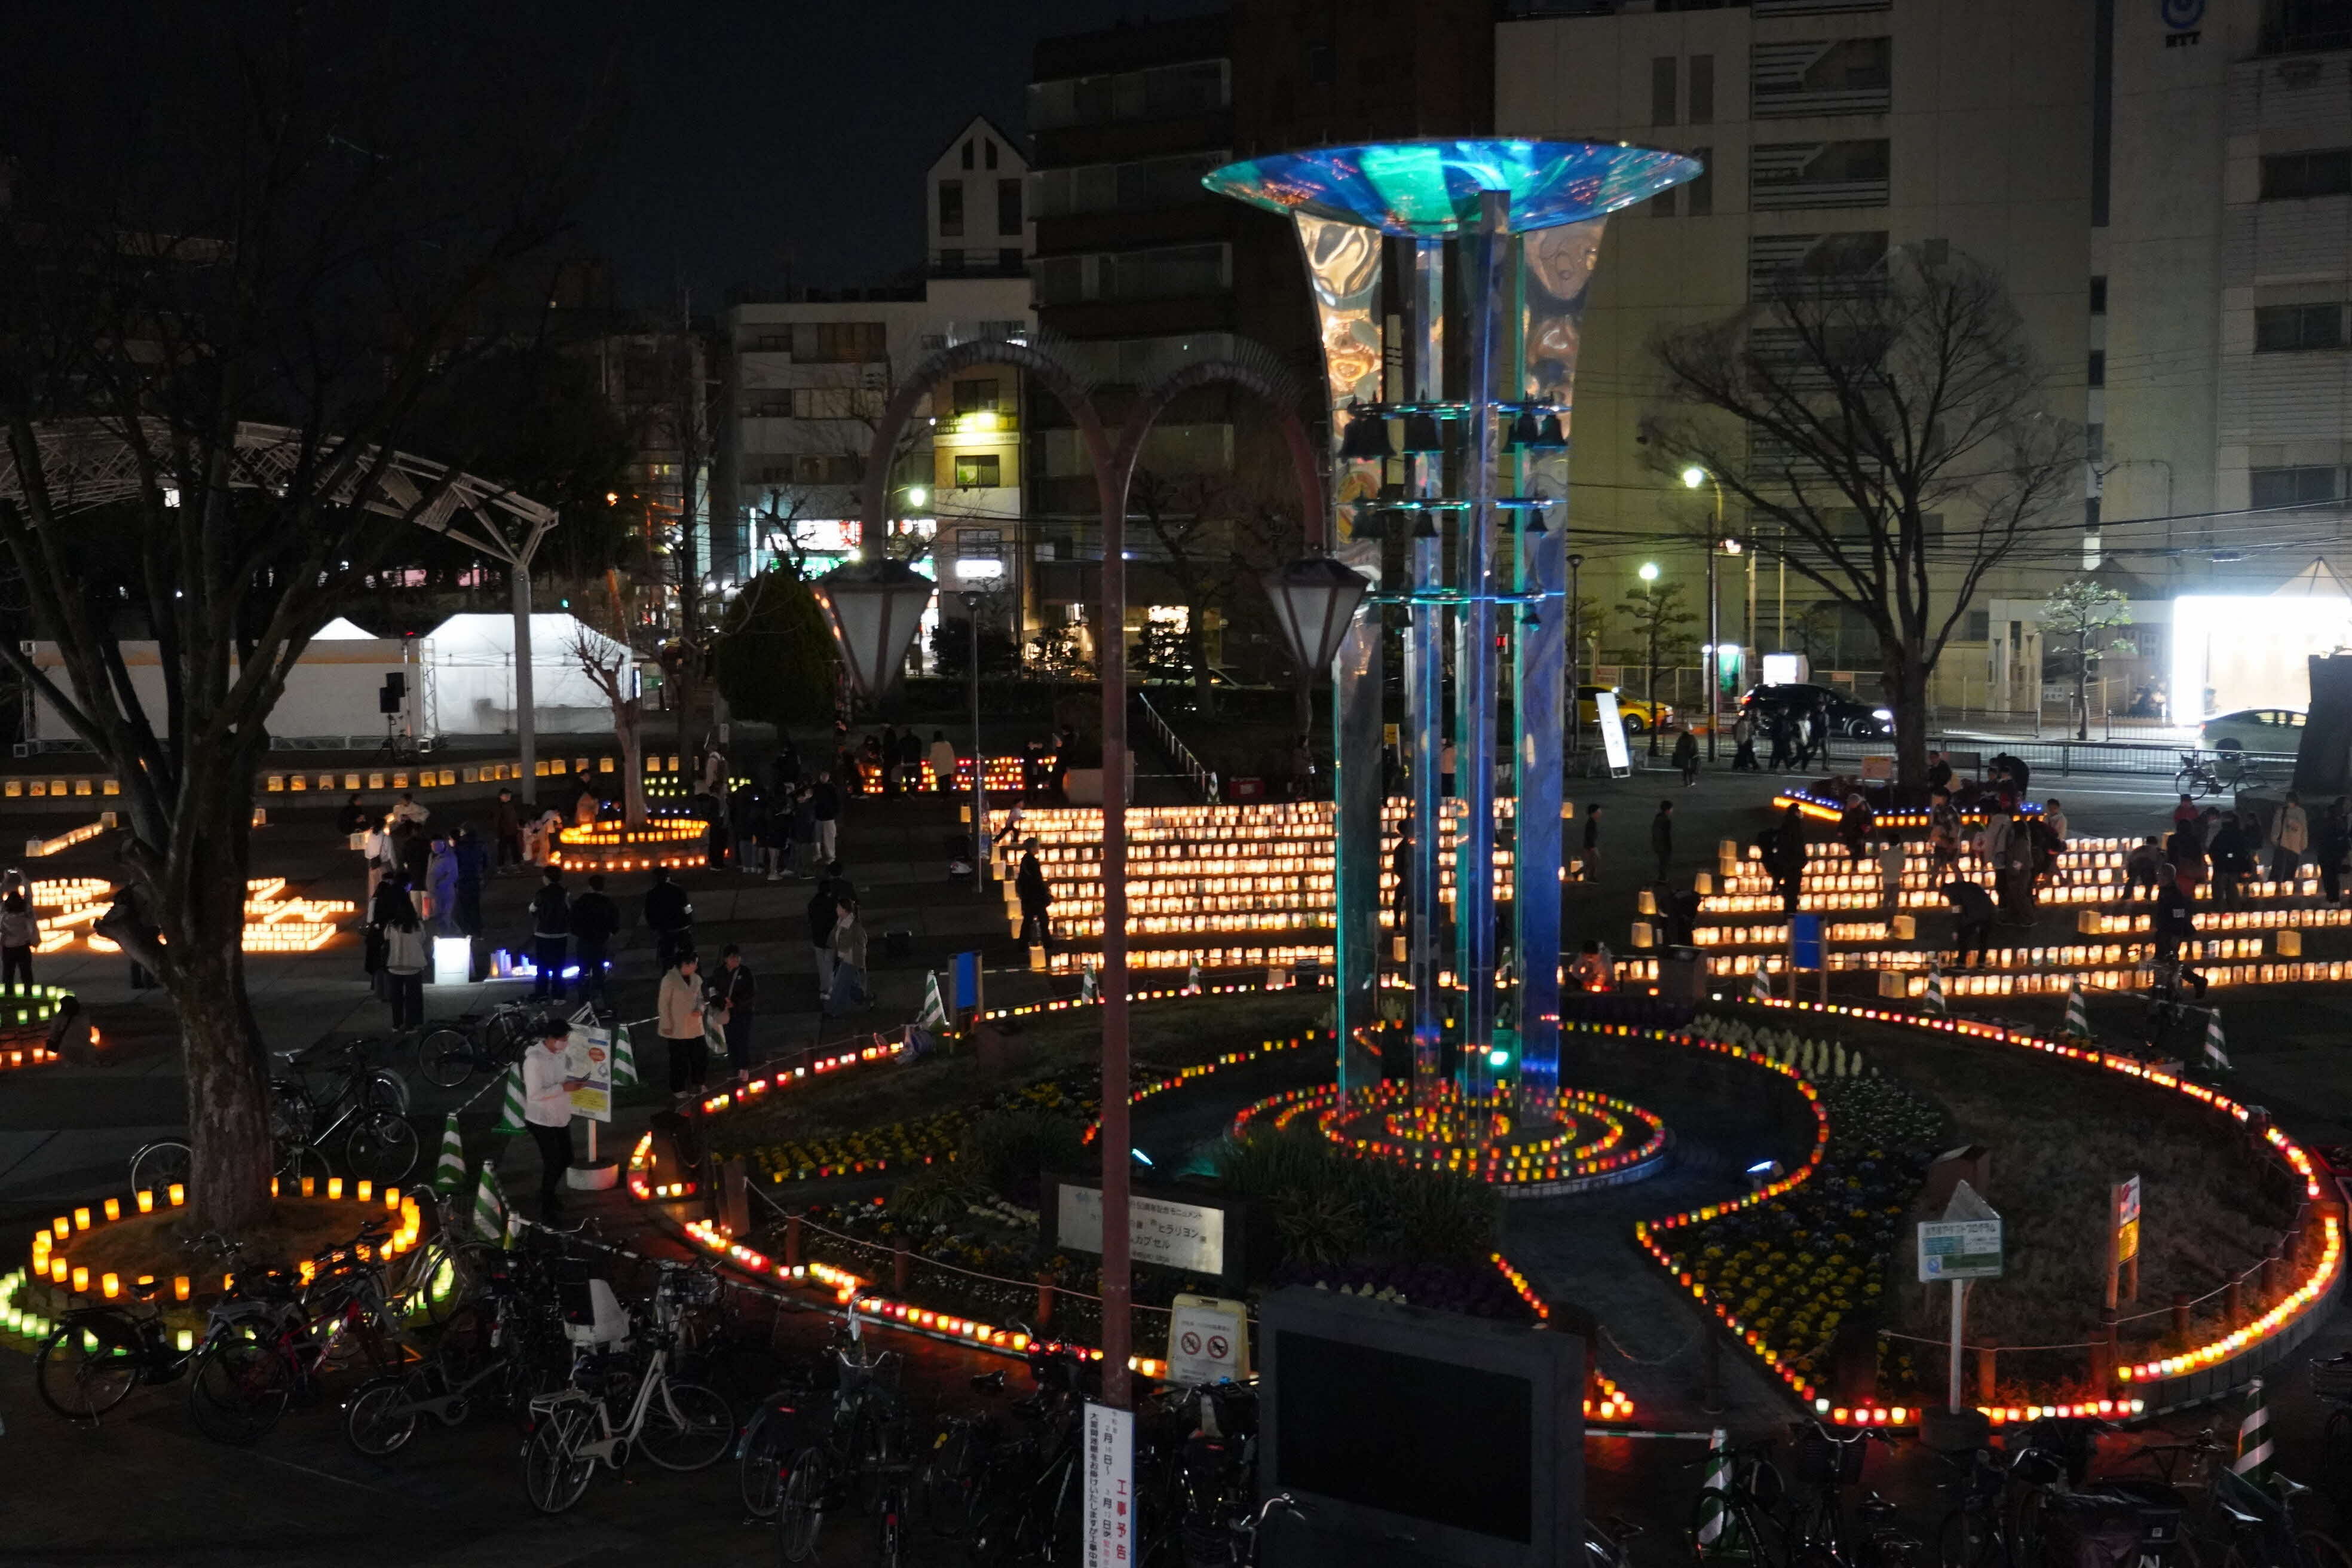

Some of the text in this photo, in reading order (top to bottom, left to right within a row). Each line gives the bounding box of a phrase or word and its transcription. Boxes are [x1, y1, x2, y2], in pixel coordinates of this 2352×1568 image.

[2165, 32, 2202, 48] NTT
[1158, 1223, 1199, 1239] ヒラリヨン
[1116, 1478, 1128, 1561] 工事予告
